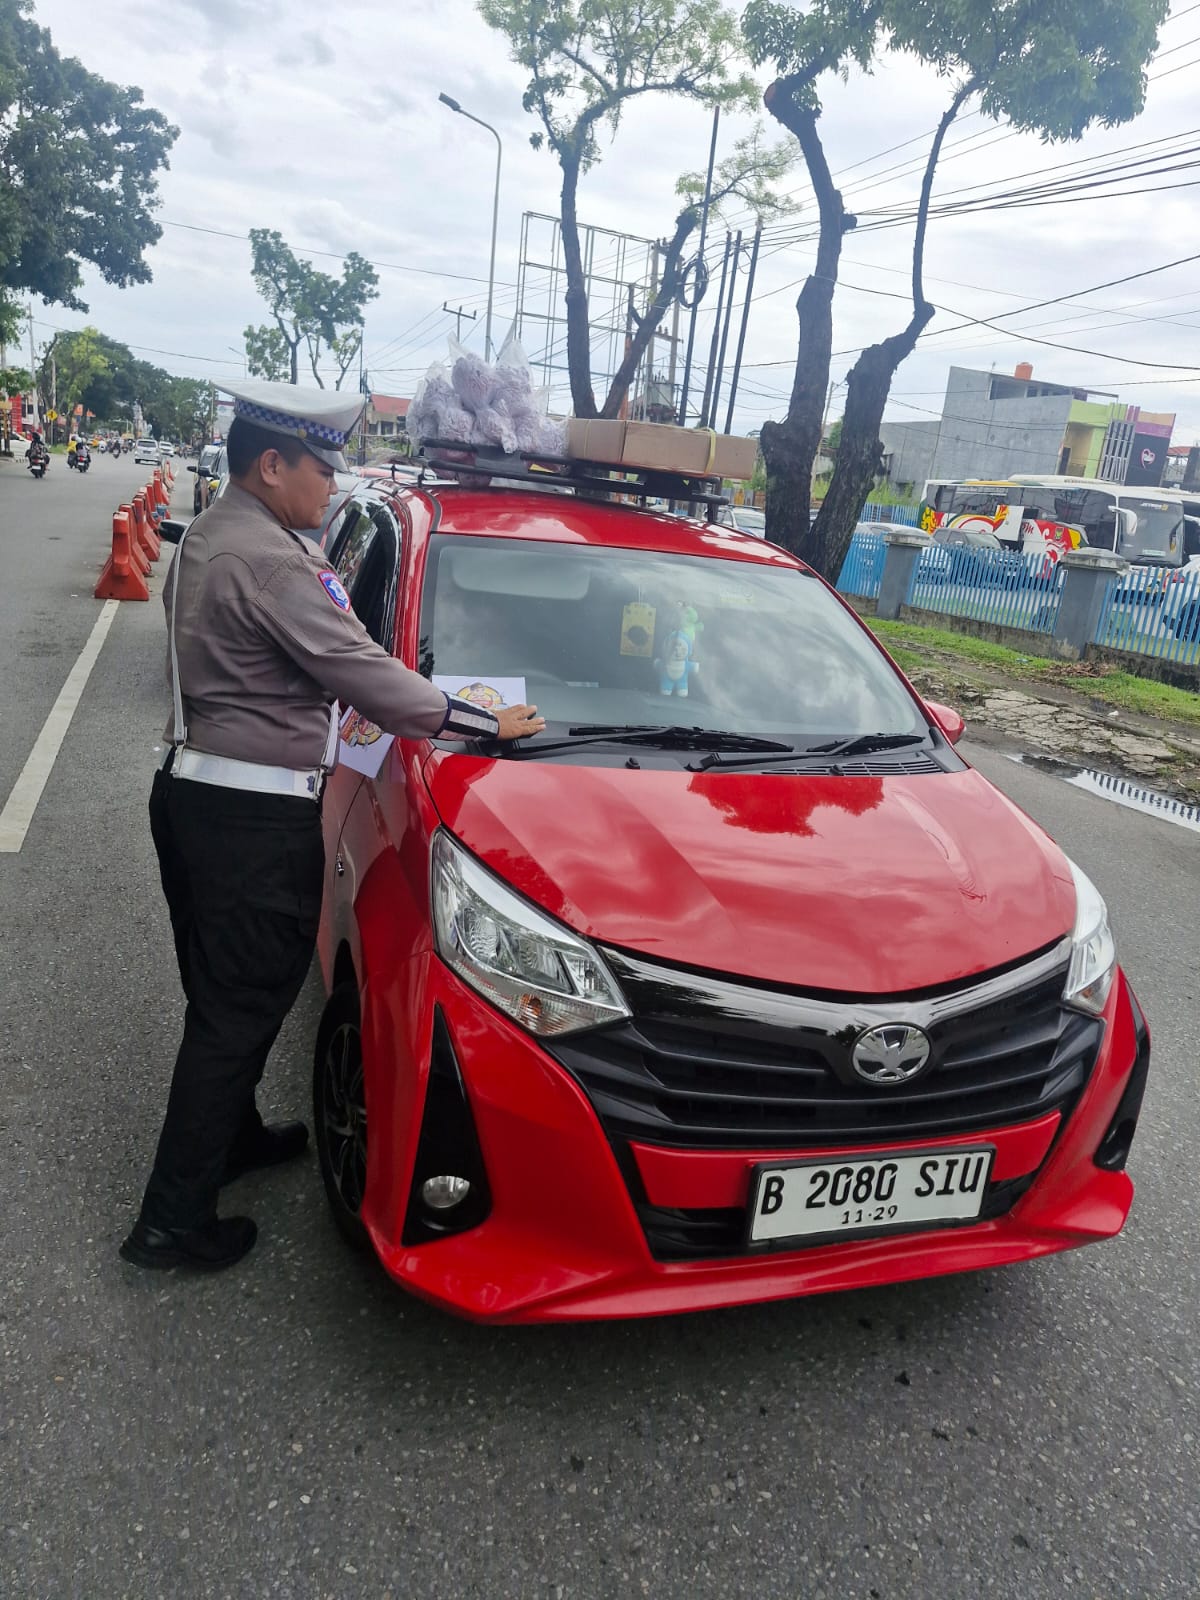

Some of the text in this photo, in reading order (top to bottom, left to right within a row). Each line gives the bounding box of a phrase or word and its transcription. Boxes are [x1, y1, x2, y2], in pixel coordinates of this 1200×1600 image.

[761, 1157, 984, 1215] B 2080 SIU
